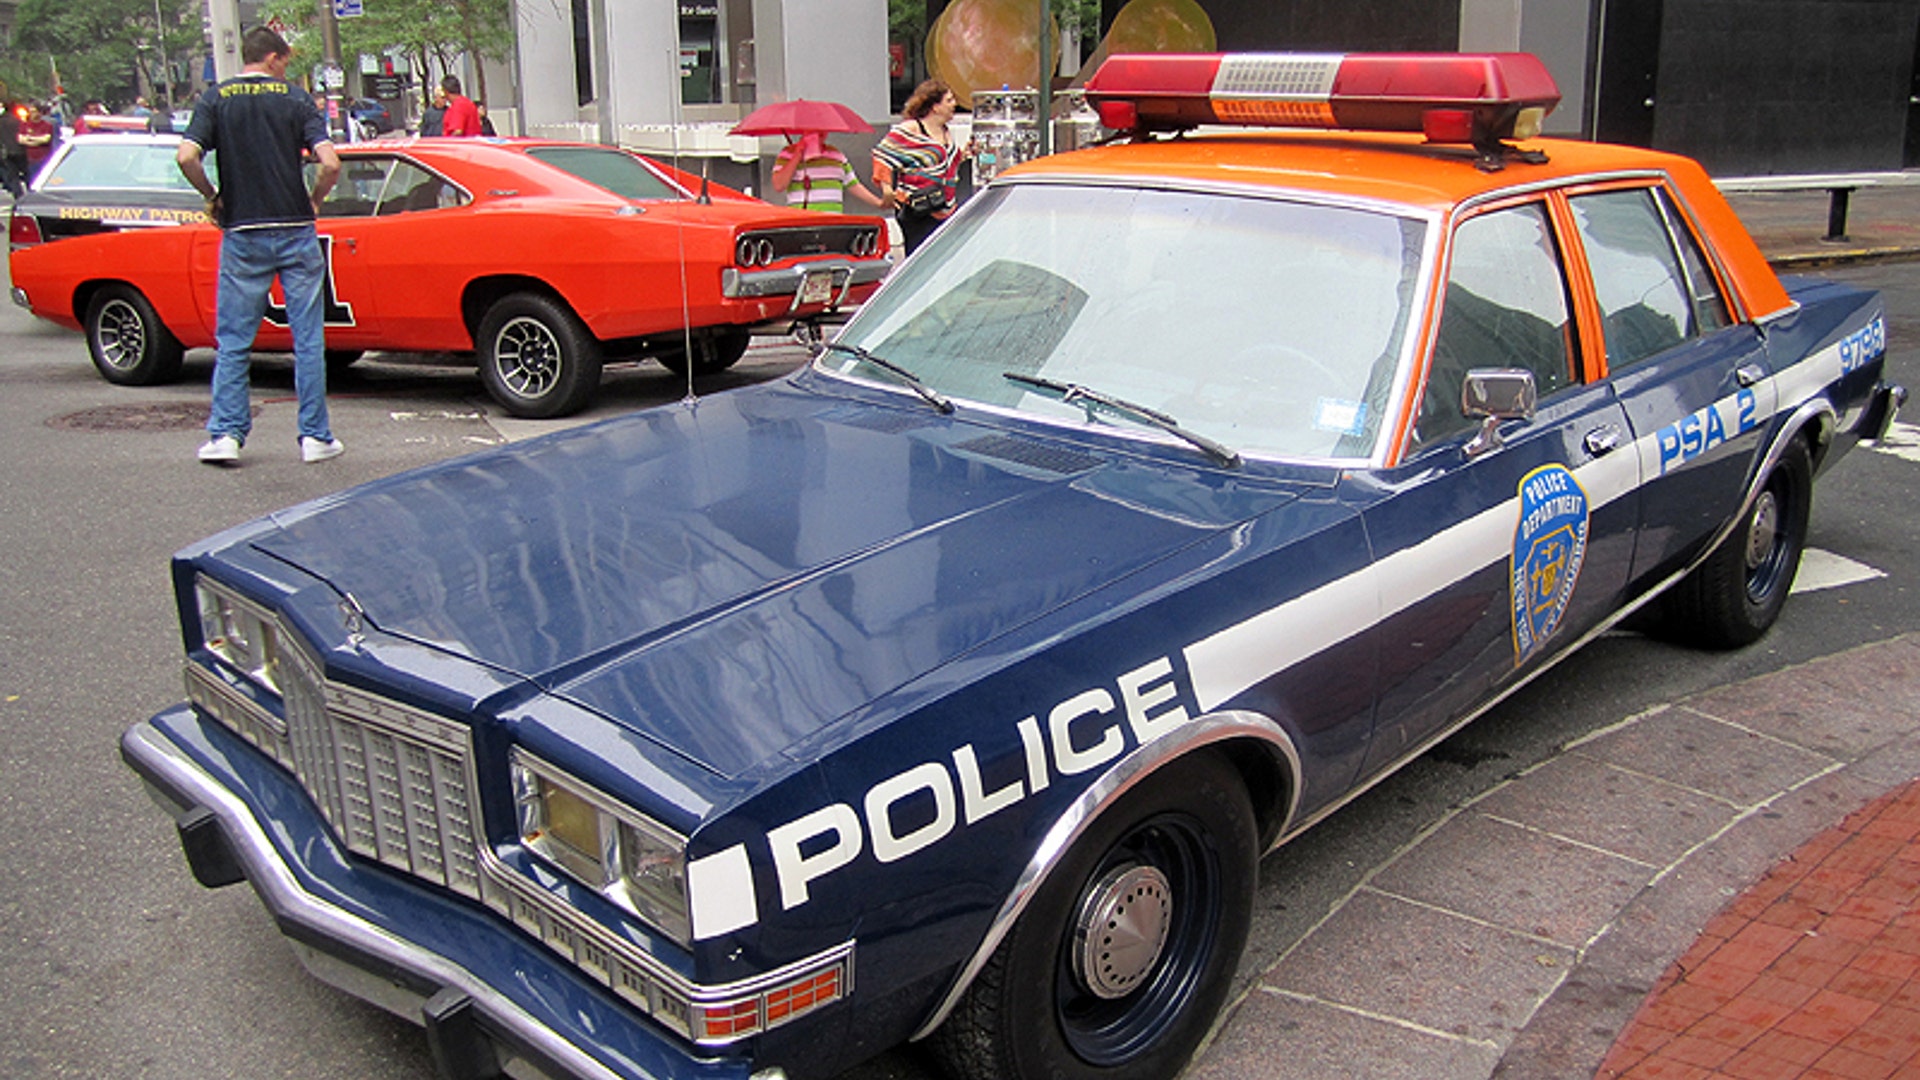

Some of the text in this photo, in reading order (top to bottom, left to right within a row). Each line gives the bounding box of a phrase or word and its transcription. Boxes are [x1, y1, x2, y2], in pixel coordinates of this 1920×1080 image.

[58, 207, 210, 223] HIGHWAY PATRO
[1656, 387, 1757, 477] PSA 2
[1525, 471, 1568, 506] POLICE
[1523, 494, 1583, 540] DEPARTMENT
[766, 656, 1190, 911] POLICE
